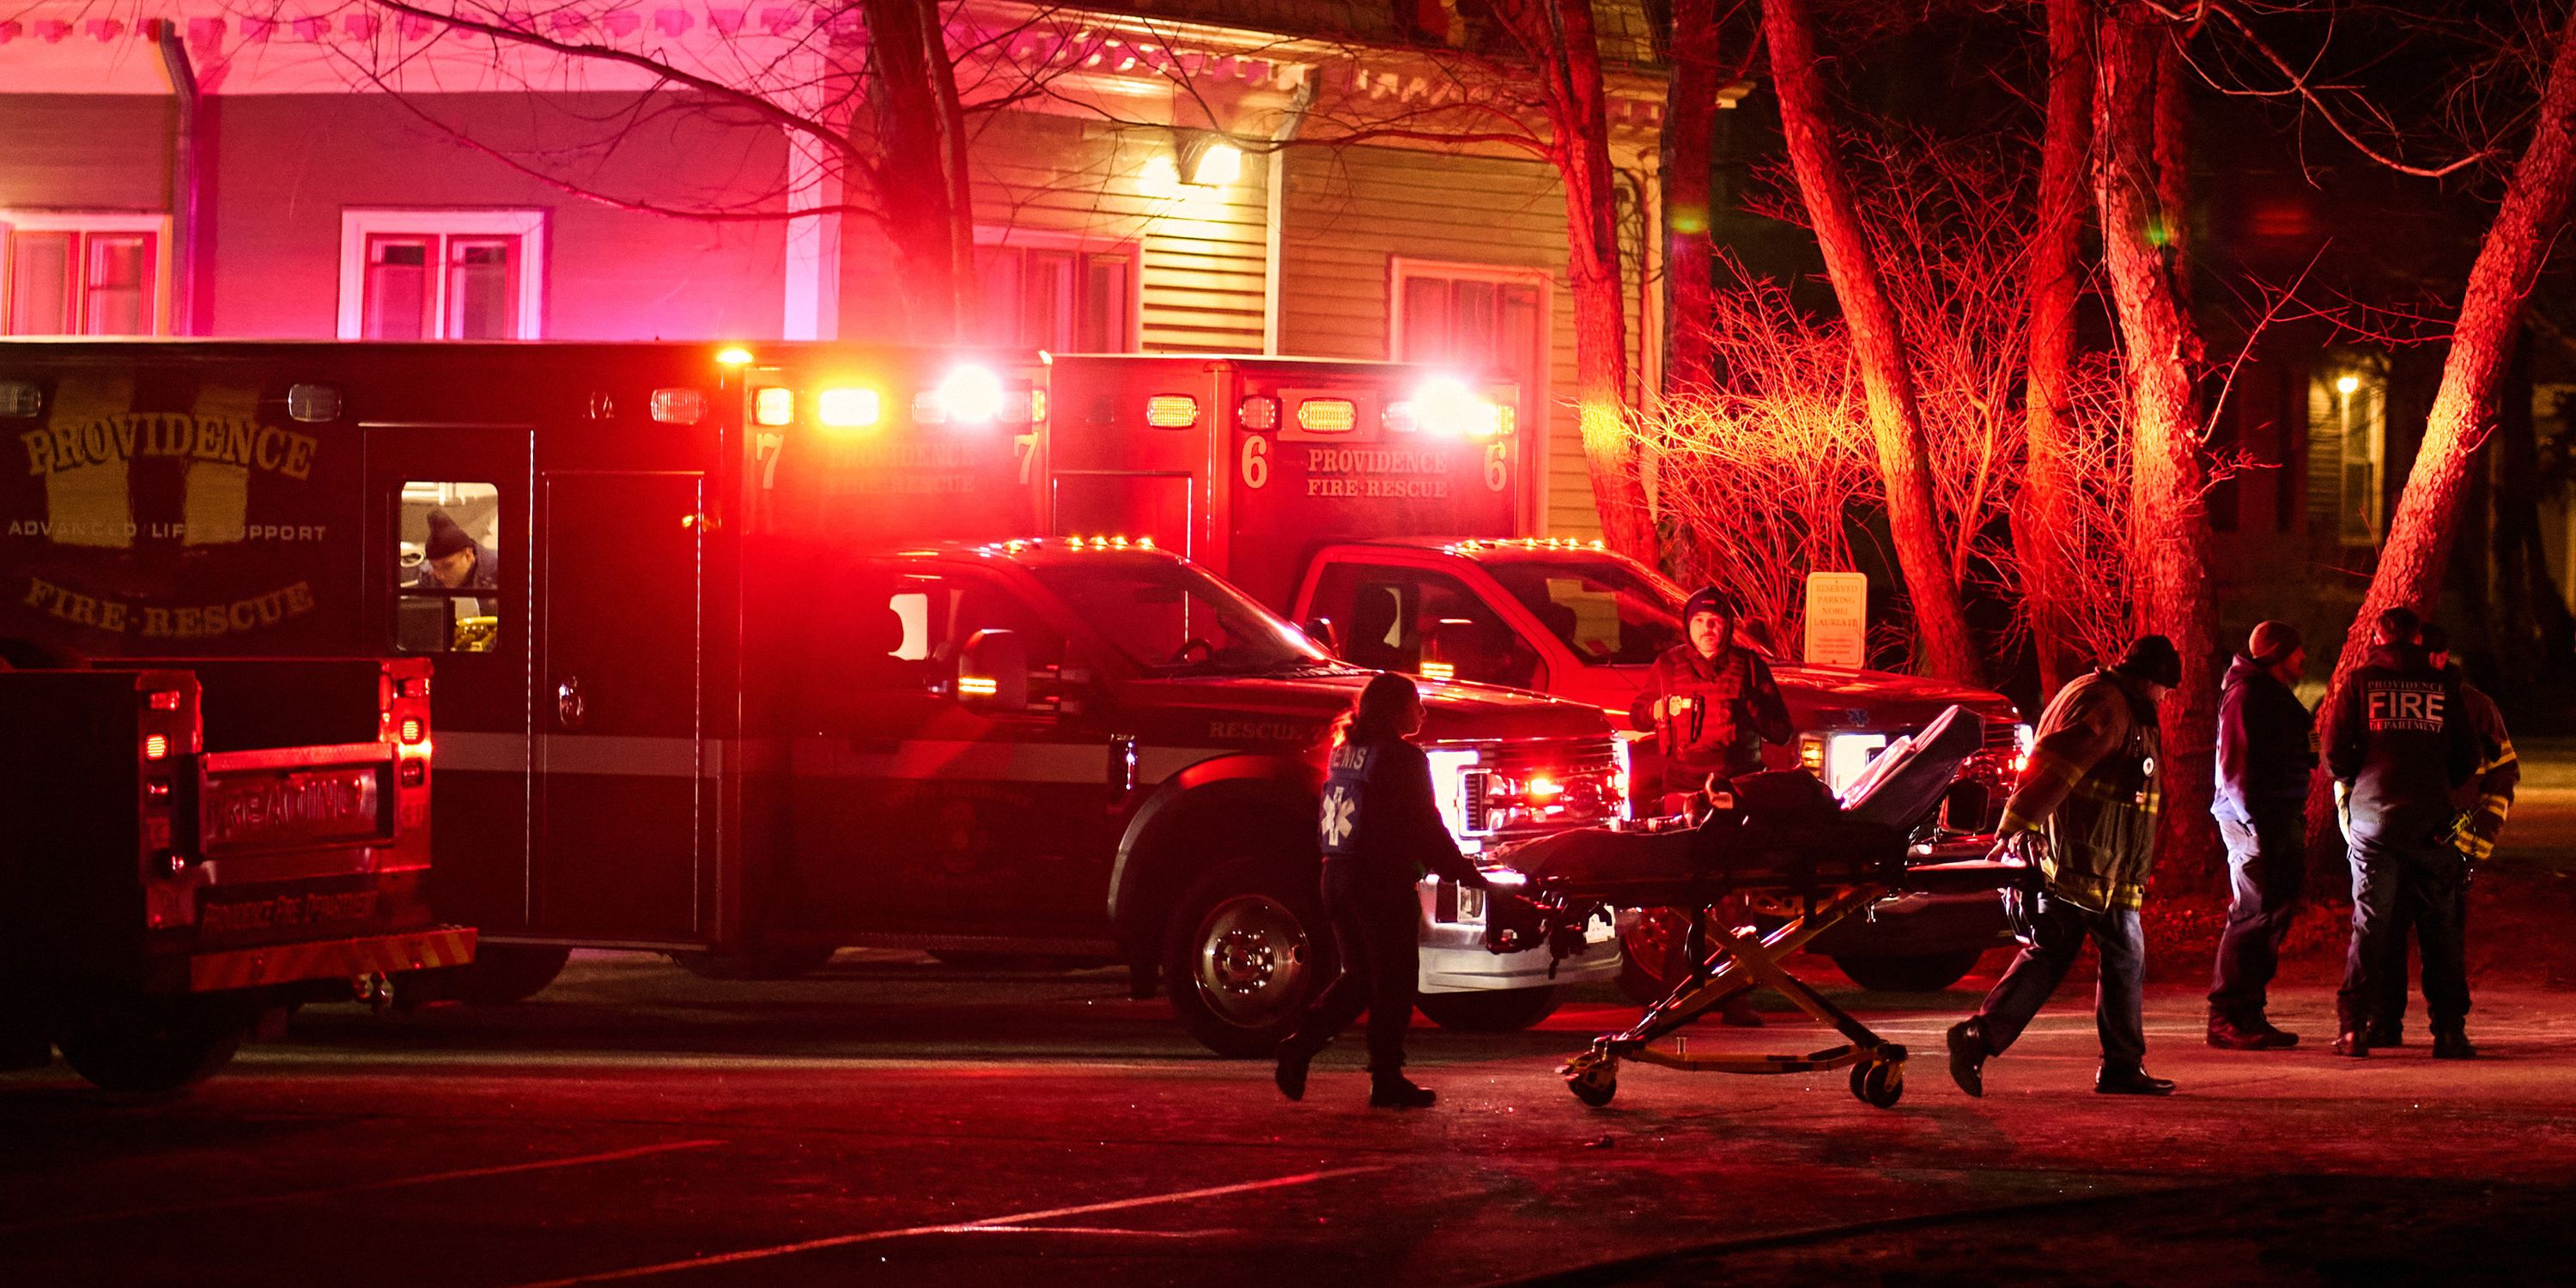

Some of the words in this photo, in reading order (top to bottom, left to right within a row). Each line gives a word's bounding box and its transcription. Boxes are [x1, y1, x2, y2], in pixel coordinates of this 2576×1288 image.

[21, 411, 319, 481] PROVIDENCE
[1013, 431, 1039, 485] 7
[756, 433, 785, 489] 7
[1242, 434, 1268, 489] 6
[1308, 448, 1447, 473] PROVIDENCE
[1484, 440, 1507, 492] 6
[8, 519, 137, 538] ADVANCED
[1816, 584, 1858, 592] RESERVED
[1814, 618, 1858, 628] LAUREATE
[1821, 607, 1849, 616] NOBEL
[2367, 679, 2444, 692] PROVIDENCE
[2367, 692, 2445, 721] FIRE
[1209, 720, 1303, 741] RESCUE
[2369, 720, 2443, 733] DEPARTMENT
[1332, 744, 1367, 770] EMS
